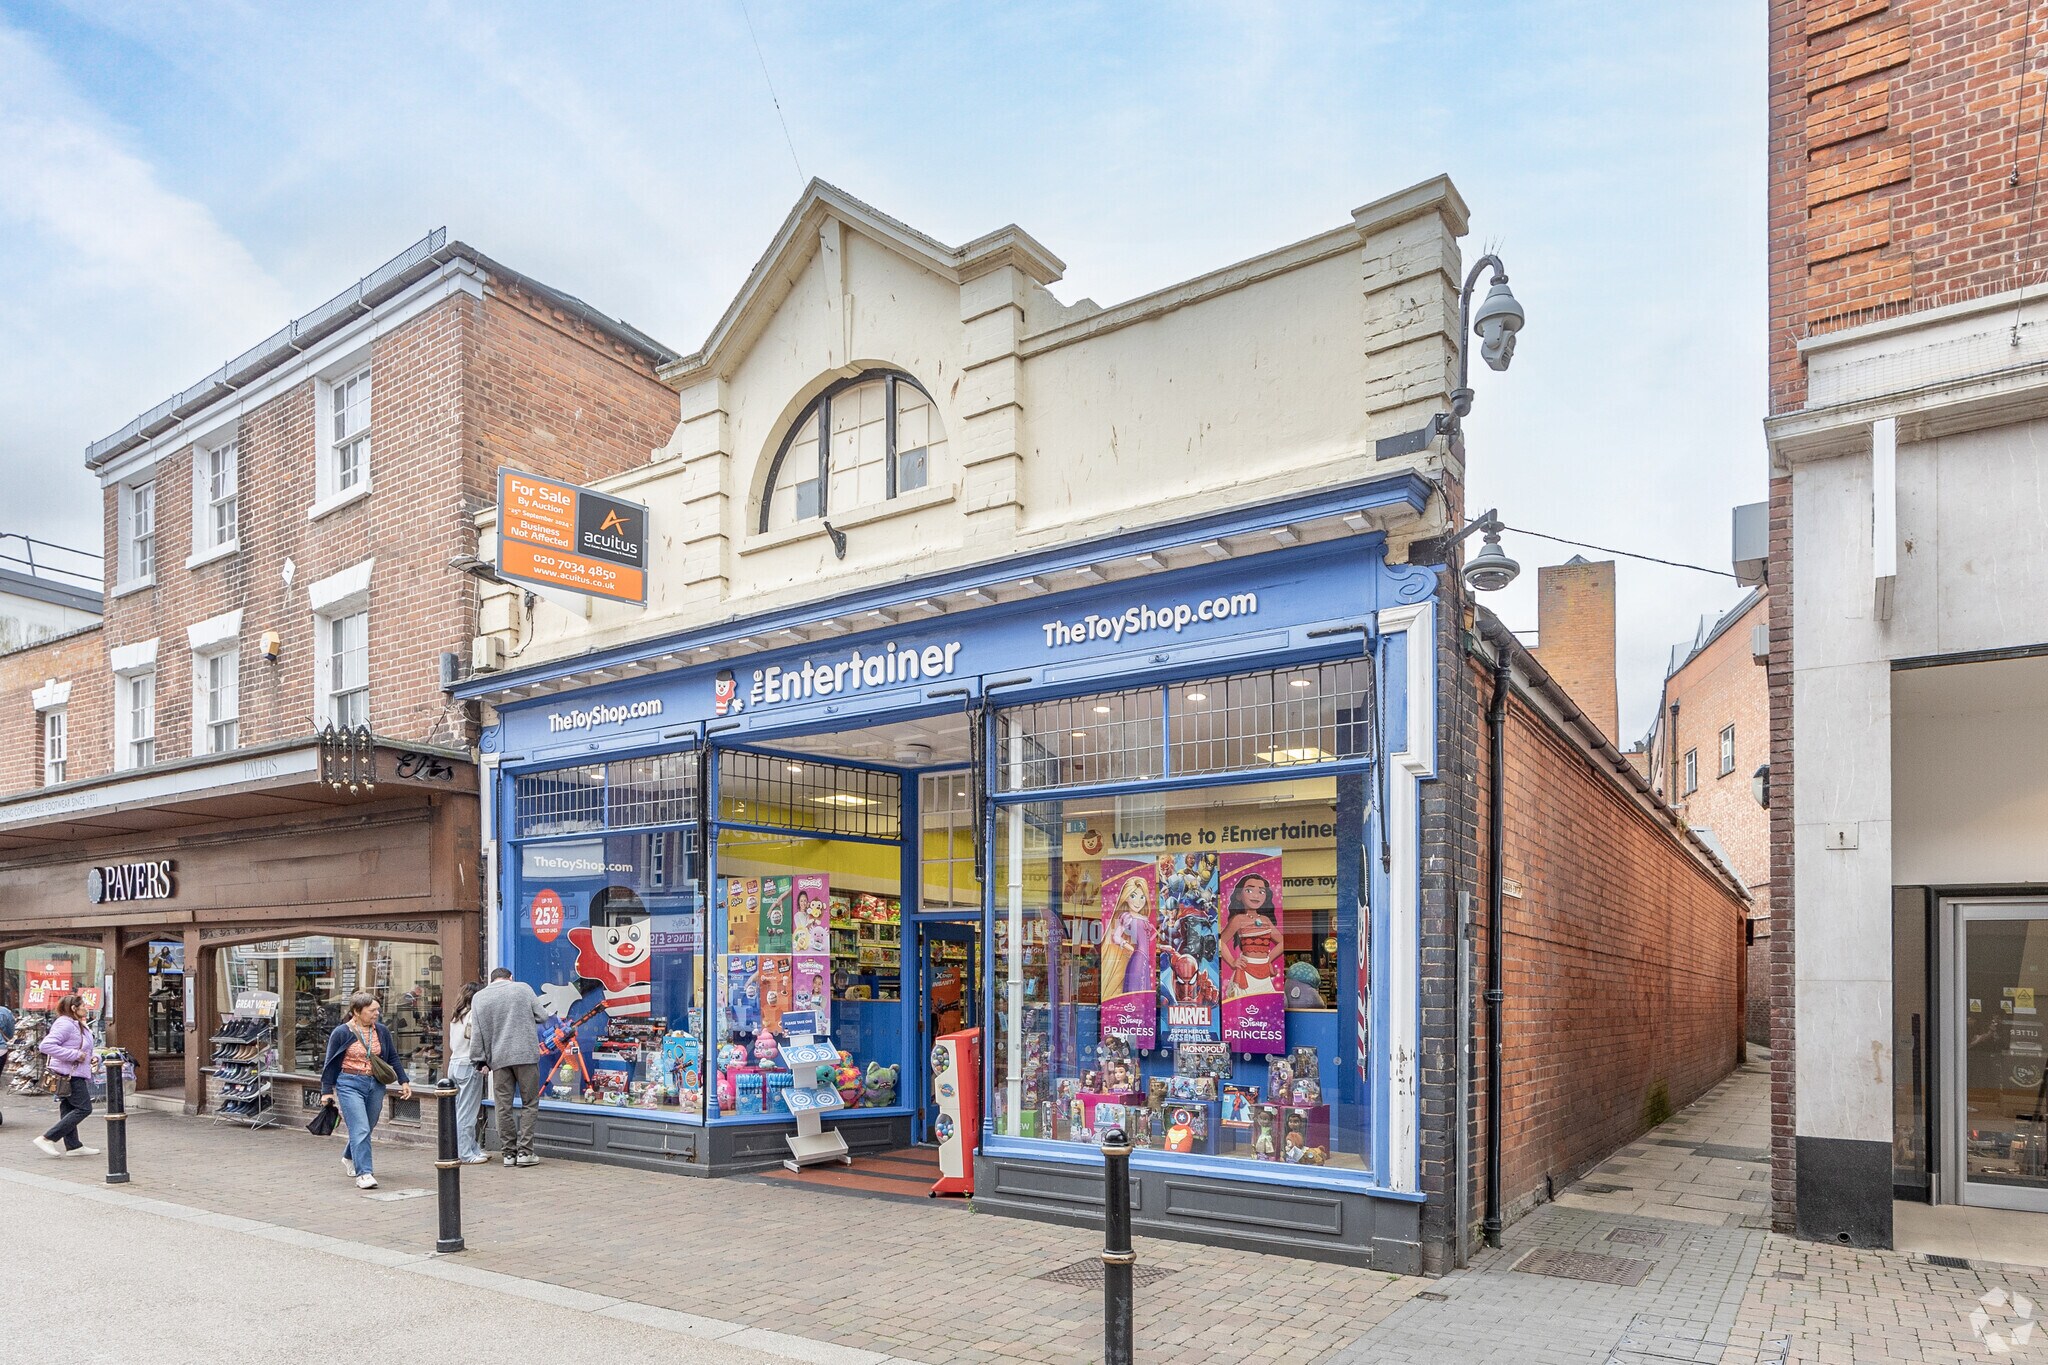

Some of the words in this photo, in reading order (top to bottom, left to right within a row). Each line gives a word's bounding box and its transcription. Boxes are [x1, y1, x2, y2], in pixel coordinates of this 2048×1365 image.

[511, 480, 535, 496] For
[538, 487, 571, 506] Sale
[517, 496, 530, 507] By
[533, 500, 564, 514] Auction
[522, 510, 554, 523] September
[511, 526, 529, 538] Not
[531, 531, 569, 547] Affected
[520, 520, 560, 537] Business
[583, 531, 638, 554] acuitus
[533, 554, 555, 566] 020
[558, 559, 585, 575] 7034
[588, 565, 617, 580] 4850
[533, 565, 616, 590] www.acuitus.co.uk
[1042, 592, 1258, 647] TheToyShop.com
[750, 669, 764, 706] The
[765, 641, 962, 703] Entertainer
[548, 698, 663, 732] TheToyShop.com
[243, 758, 279, 780] PAVERS
[1112, 827, 1192, 849] Welcome
[1199, 828, 1217, 845] to
[1221, 826, 1230, 843] The
[533, 856, 633, 873] TheToyShop.com
[104, 860, 171, 902] PAVERS
[1283, 878, 1314, 888] more
[535, 906, 560, 926] 25%
[29, 979, 70, 991] SALE
[28, 991, 45, 1003] SALE
[235, 999, 255, 1009] GREAT
[1116, 1014, 1143, 1027] Disney
[1169, 1006, 1211, 1025] MARVEL
[1237, 1016, 1268, 1030] Disney
[1103, 1026, 1154, 1037] PRINCESS
[1224, 1029, 1283, 1041] PRINCESS
[684, 1040, 697, 1048] WIN
[1182, 1044, 1226, 1053] MONOPOLY
